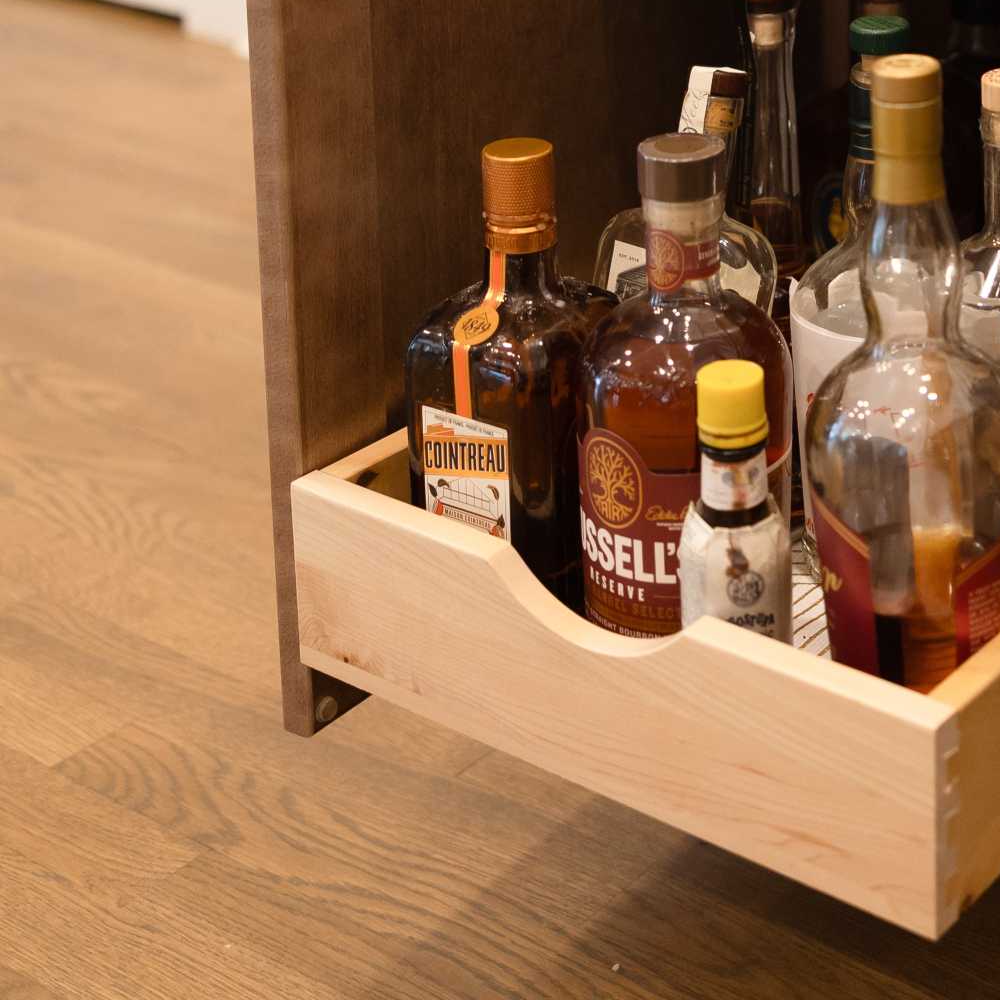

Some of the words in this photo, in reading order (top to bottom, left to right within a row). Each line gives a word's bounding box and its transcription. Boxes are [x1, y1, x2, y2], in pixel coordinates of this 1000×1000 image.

[424, 440, 505, 473] COINTREAU
[579, 504, 682, 584] USSELL'
[589, 566, 645, 602] RESERVE
